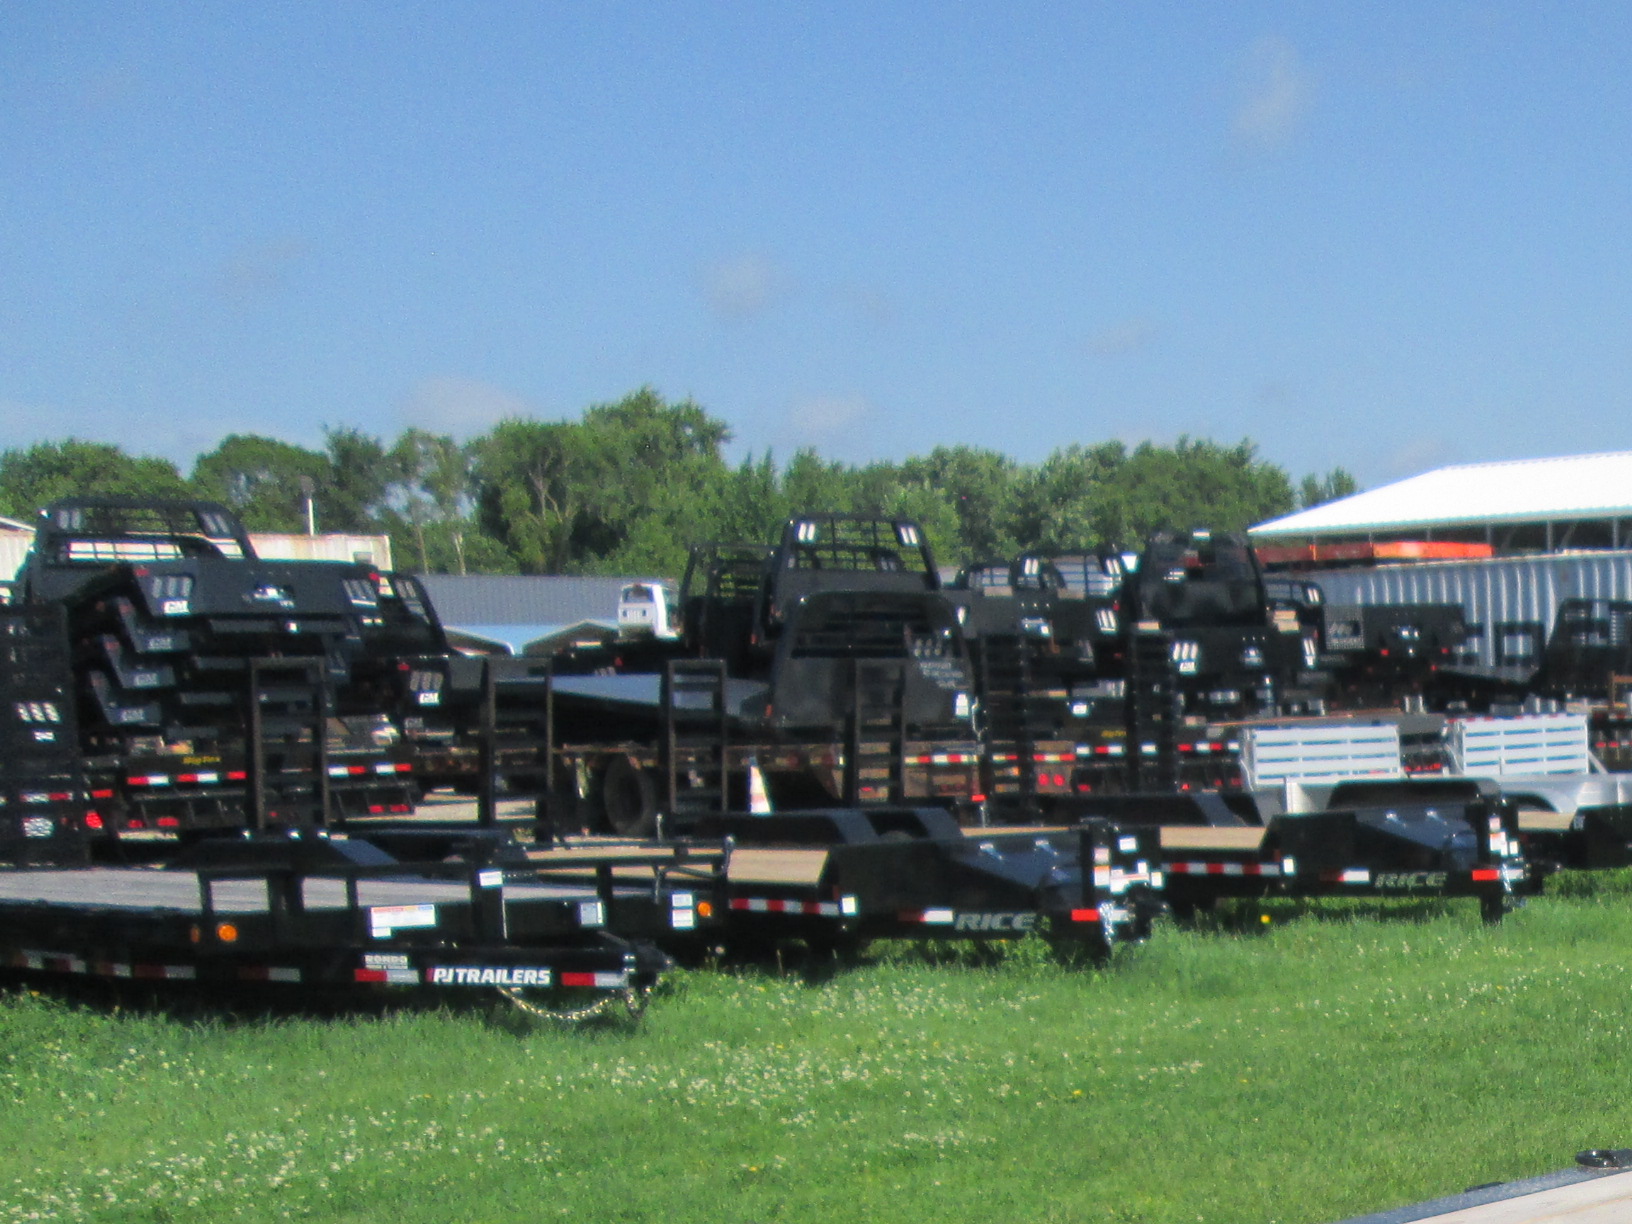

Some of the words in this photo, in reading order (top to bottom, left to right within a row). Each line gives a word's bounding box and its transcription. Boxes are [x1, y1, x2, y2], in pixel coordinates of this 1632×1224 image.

[954, 912, 1037, 931] RICE
[433, 968, 454, 983] PJ
[455, 968, 551, 985] TRAILERS
